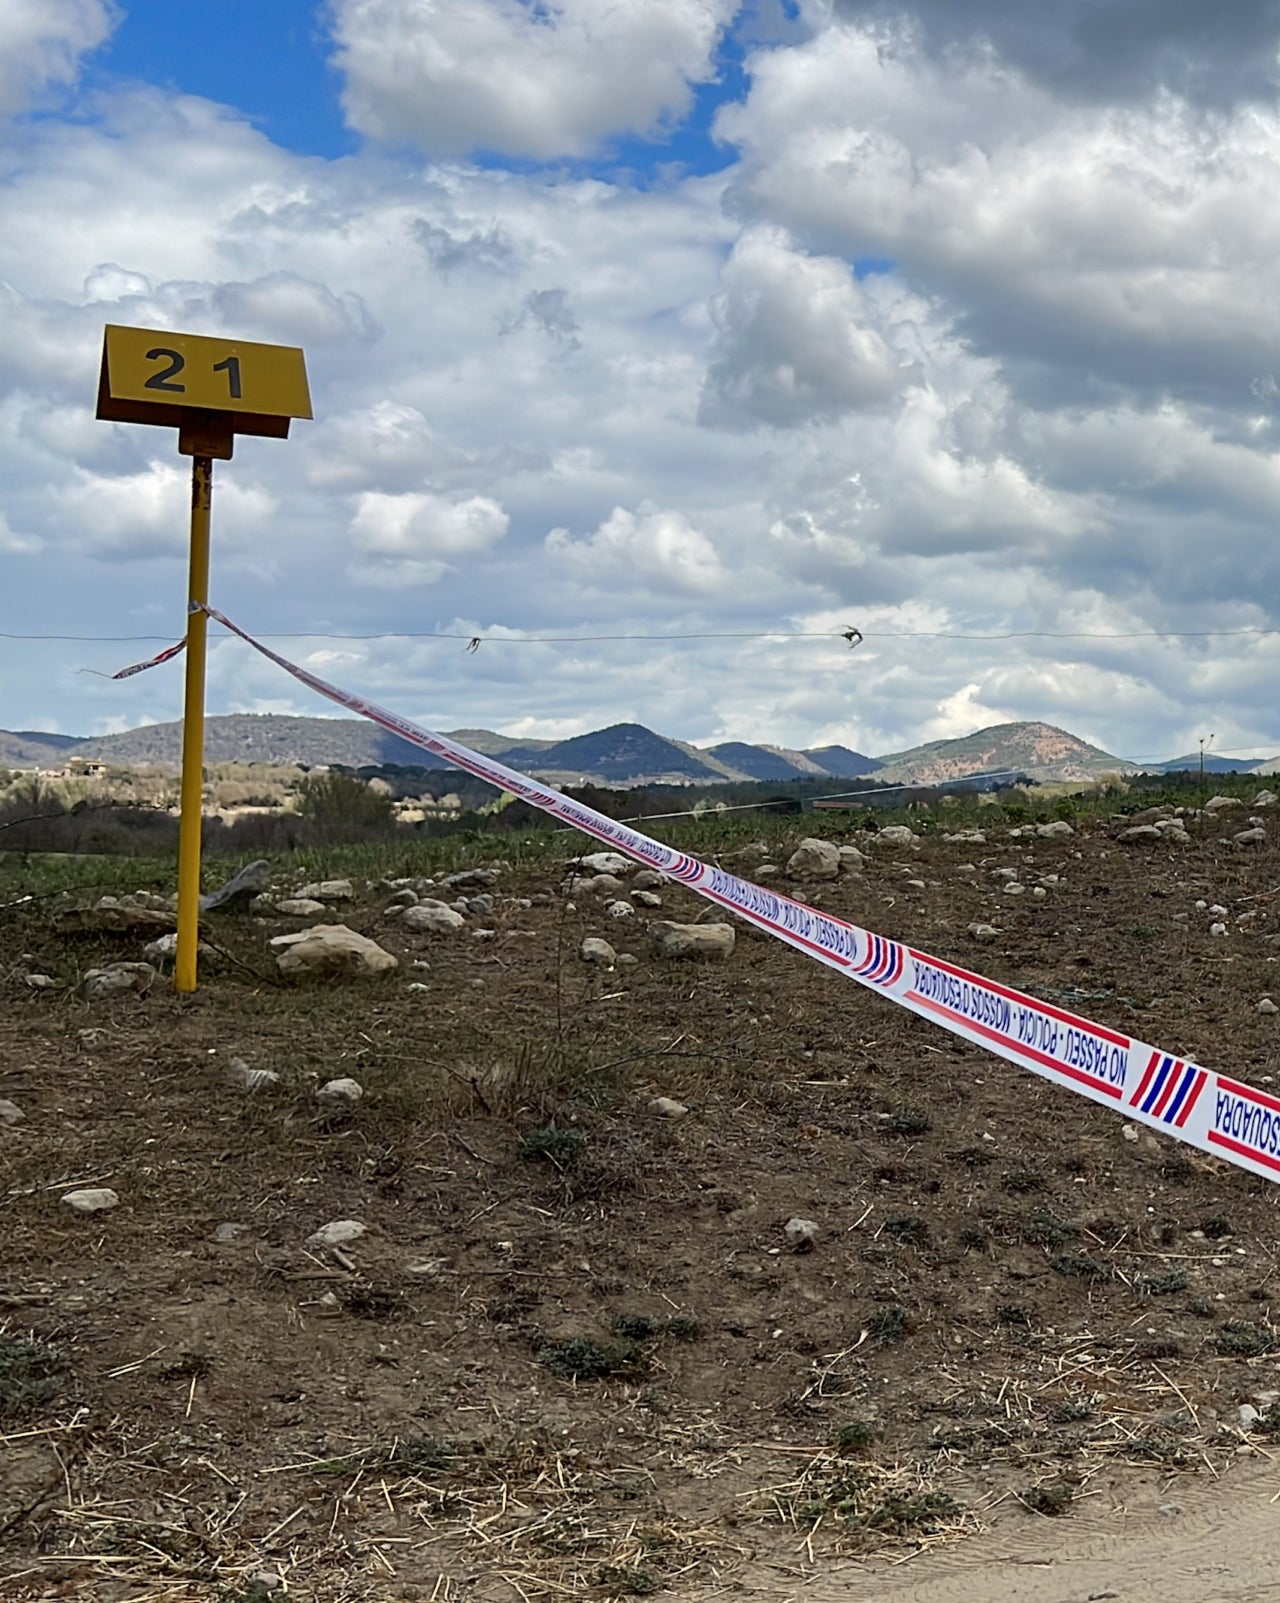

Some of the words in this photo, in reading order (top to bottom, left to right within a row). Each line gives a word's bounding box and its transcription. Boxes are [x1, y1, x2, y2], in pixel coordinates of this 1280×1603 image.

[971, 986, 1011, 1032] MOSSOS
[1018, 1008, 1058, 1054] POLICIA
[1063, 1029, 1108, 1076] PASSEU
[1111, 1048, 1128, 1086] NO
